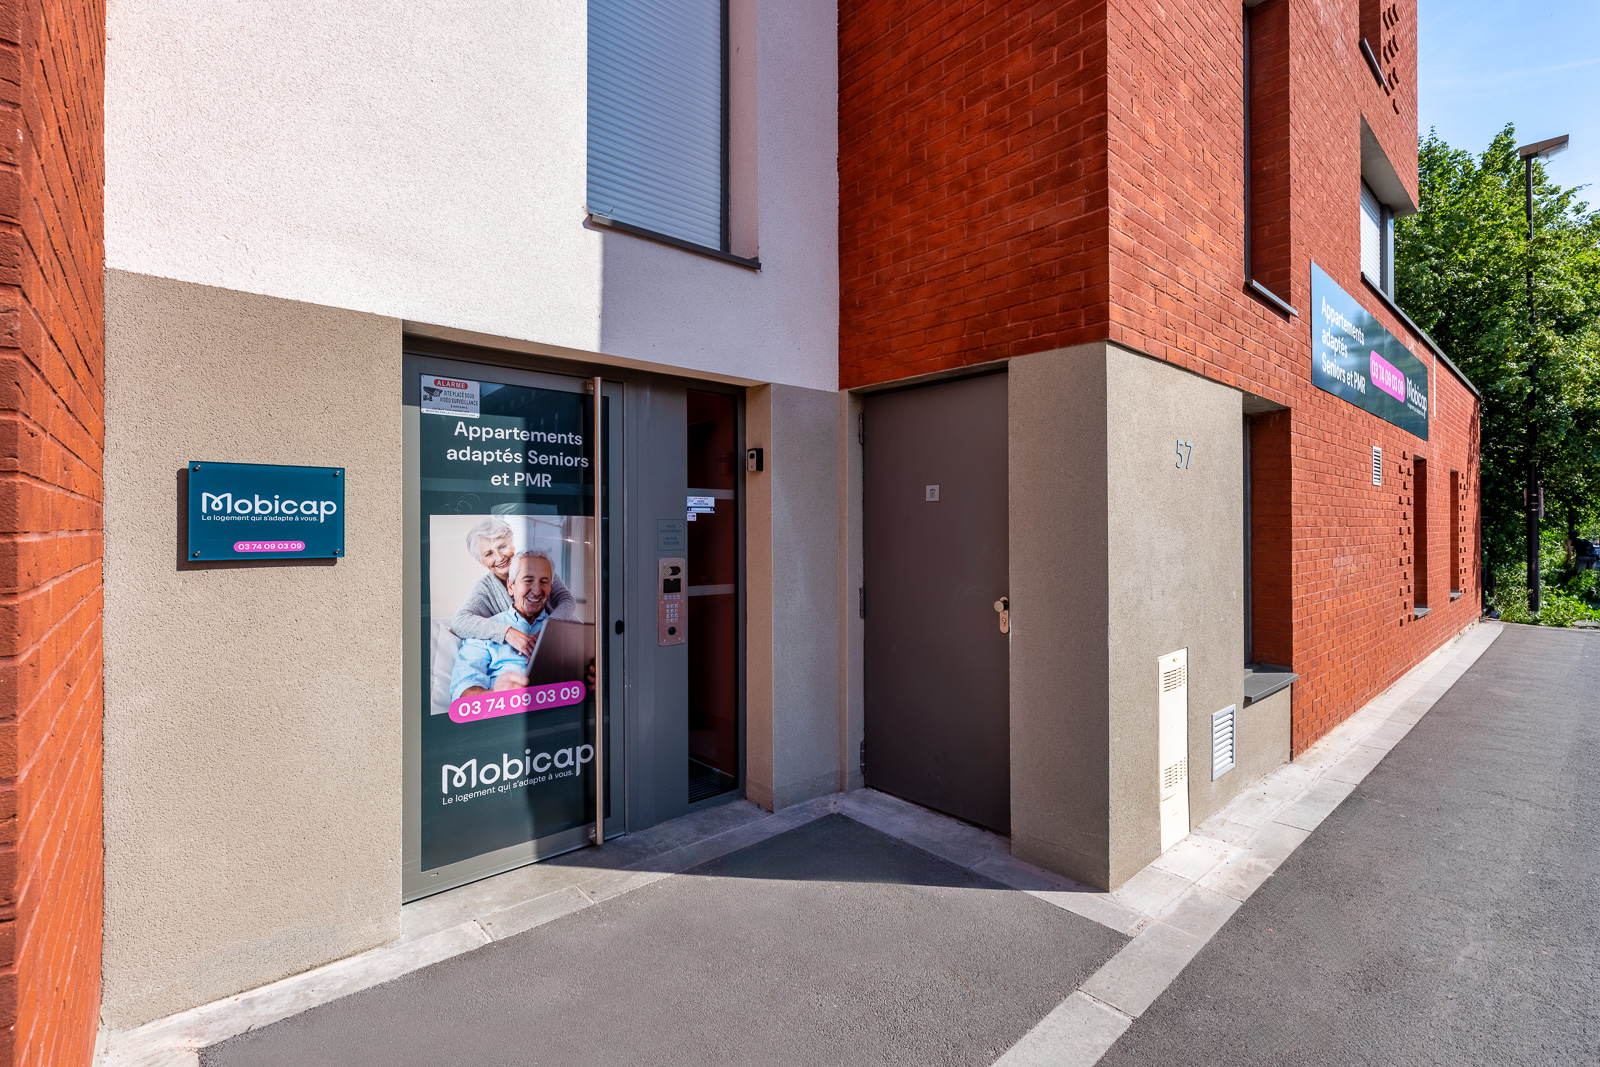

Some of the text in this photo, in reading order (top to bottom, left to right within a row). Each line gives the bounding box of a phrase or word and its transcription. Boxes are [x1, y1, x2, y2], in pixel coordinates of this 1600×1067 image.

[1321, 296, 1365, 346] Appartements
[1321, 328, 1348, 358] adaptés
[436, 379, 466, 389] ALARME
[1321, 352, 1366, 395] Seniors et PMR
[1371, 359, 1404, 396] 03 74 09 03 09
[1406, 376, 1427, 420] Mobicap
[453, 421, 583, 446] Appartements
[446, 446, 589, 468] adaptés Seniors
[1175, 440, 1194, 469] 57
[490, 472, 552, 488] et PMR
[201, 491, 337, 523] Mobicap
[213, 514, 250, 522] logement
[458, 686, 580, 717] 03 74 09 03 09
[441, 743, 595, 795] Mobicap
[442, 796, 453, 805] Le
[455, 786, 496, 803] logement
[497, 782, 511, 794] qui
[554, 769, 574, 779] vous.
